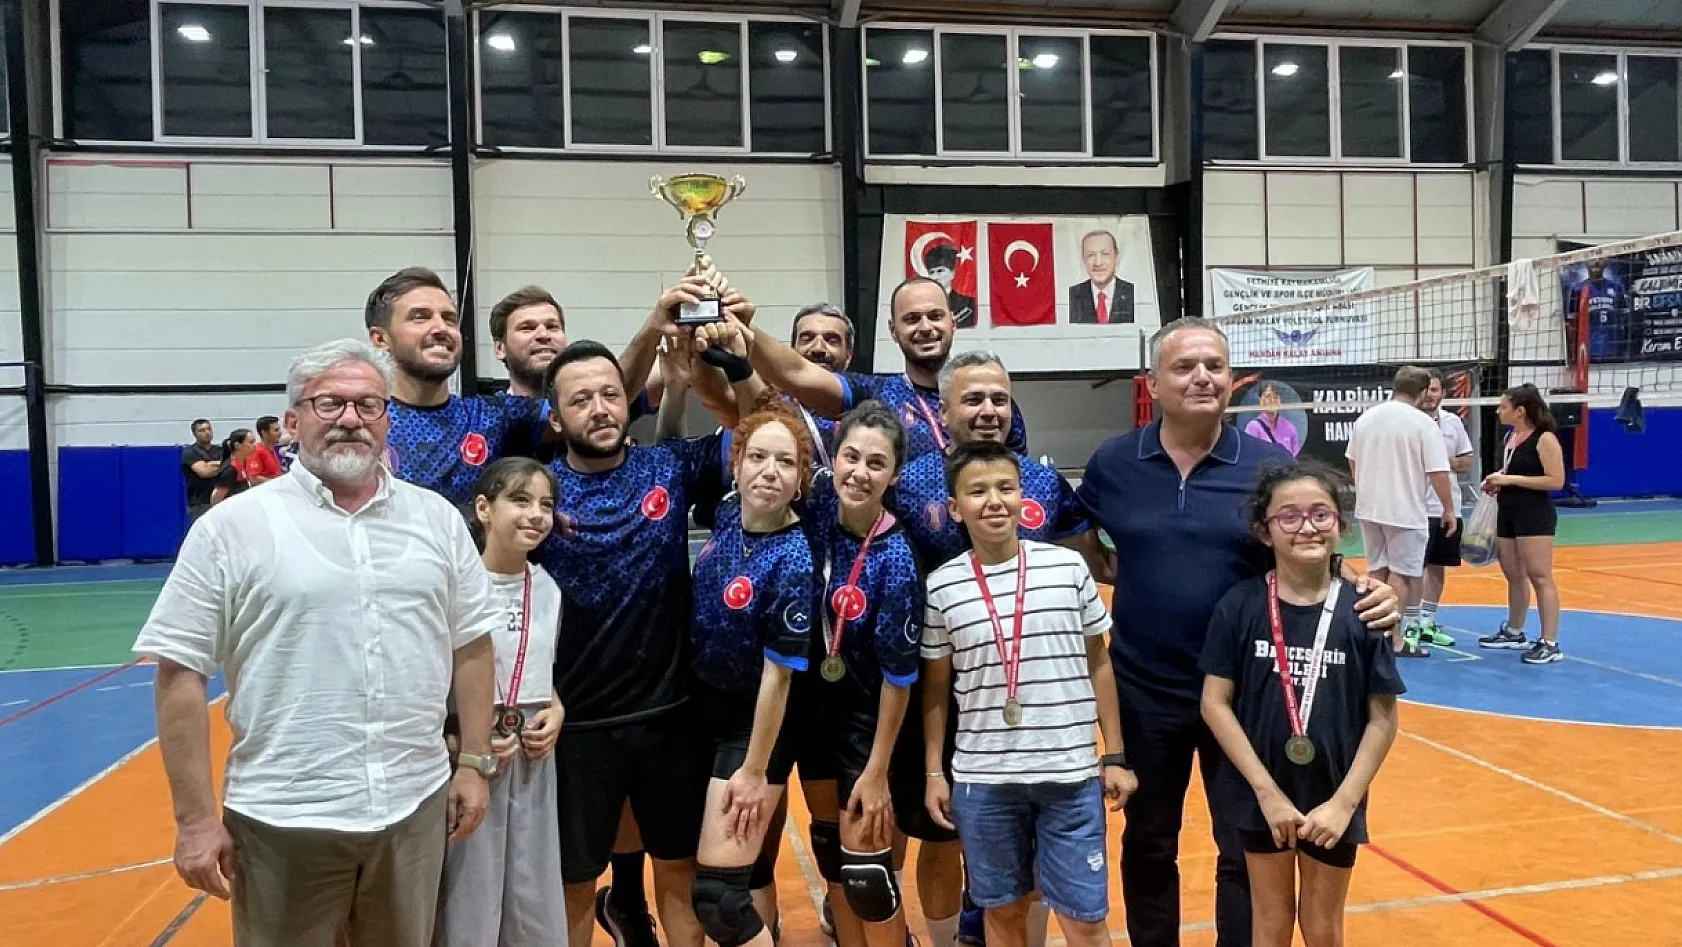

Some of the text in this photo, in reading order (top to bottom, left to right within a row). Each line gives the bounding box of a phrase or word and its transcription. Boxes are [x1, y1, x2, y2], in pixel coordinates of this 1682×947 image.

[1224, 289, 1258, 300] GENÇLİK
[1260, 290, 1272, 298] VE
[1274, 290, 1295, 298] SPOR
